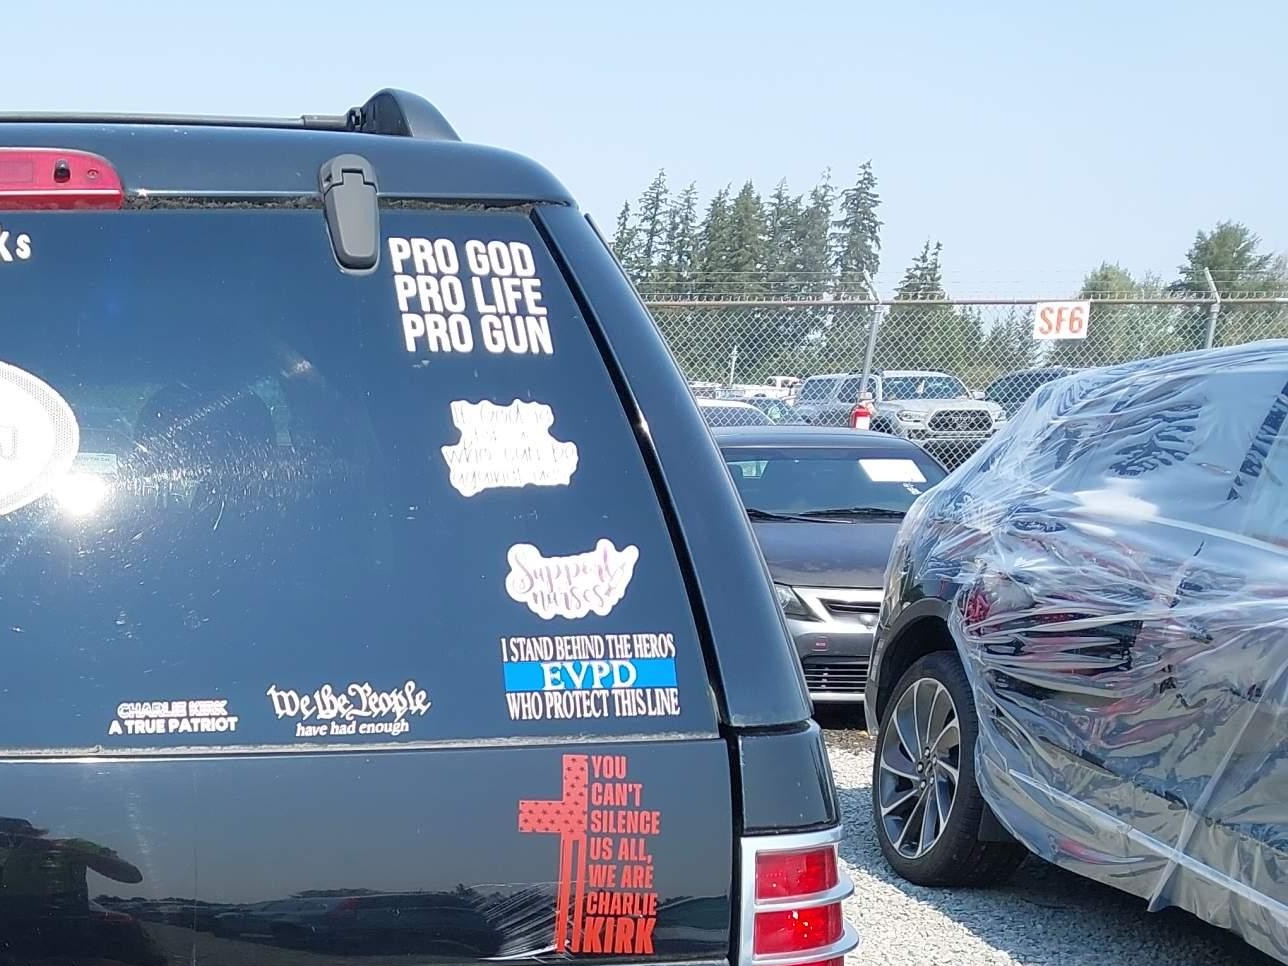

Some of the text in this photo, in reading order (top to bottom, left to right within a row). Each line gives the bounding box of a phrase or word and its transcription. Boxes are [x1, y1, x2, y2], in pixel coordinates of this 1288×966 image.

[388, 237, 536, 277] PRO GOD
[394, 275, 548, 315] PRO LIFE
[402, 313, 554, 355] PRO GUN
[1039, 306, 1084, 335] SF6
[501, 638, 509, 662] I
[510, 636, 554, 661] STAND
[555, 635, 604, 660] BEHIND
[605, 634, 633, 659] THE
[541, 660, 638, 690] EVPD
[267, 684, 316, 720] We
[346, 680, 432, 721] People
[506, 688, 680, 720] WHO PROTECT THIS LINE
[108, 717, 239, 735] A TRUE PATRIOT
[296, 719, 409, 737] have had enough
[591, 756, 627, 779] YOU
[591, 783, 643, 807] CAN'T
[591, 810, 660, 835] SILENCE
[589, 837, 652, 864] US ALL,
[588, 864, 654, 889] WE ARE
[586, 892, 658, 916] CHARLIE
[583, 917, 657, 954] KIRK
